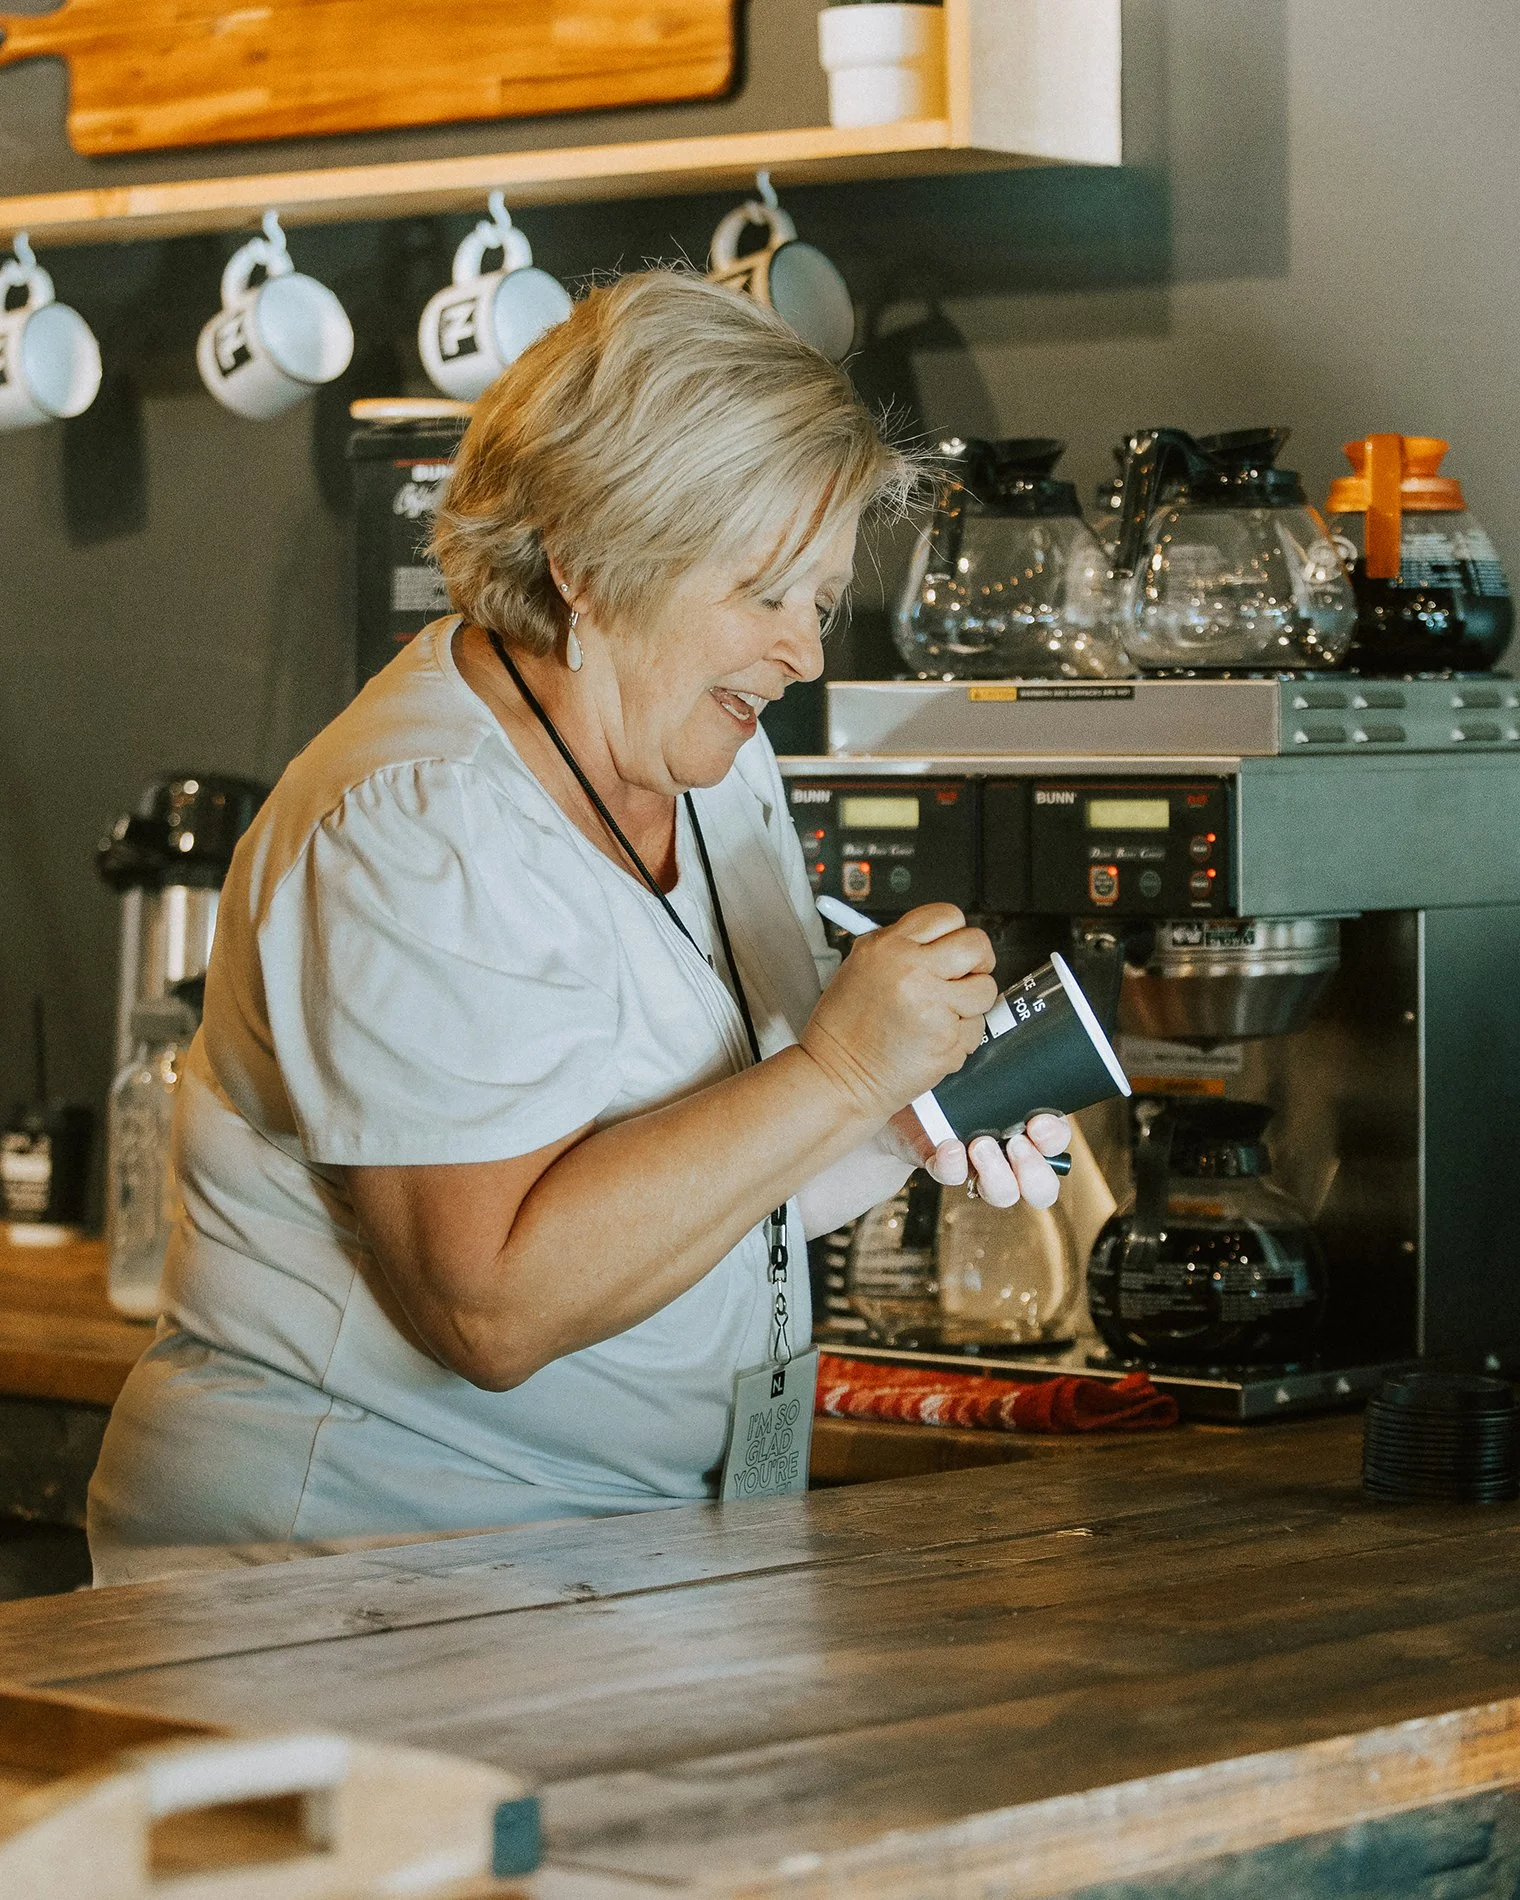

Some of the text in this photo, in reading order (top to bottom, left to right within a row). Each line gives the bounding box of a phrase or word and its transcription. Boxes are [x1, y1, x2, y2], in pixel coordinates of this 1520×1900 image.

[1035, 791, 1075, 804] BUNN
[1014, 996, 1031, 1022] FOR
[1033, 998, 1046, 1012] IS
[747, 1399, 800, 1441] I'M SO
[745, 1427, 794, 1466] GLAD
[733, 1451, 799, 1498] YOU'RE
